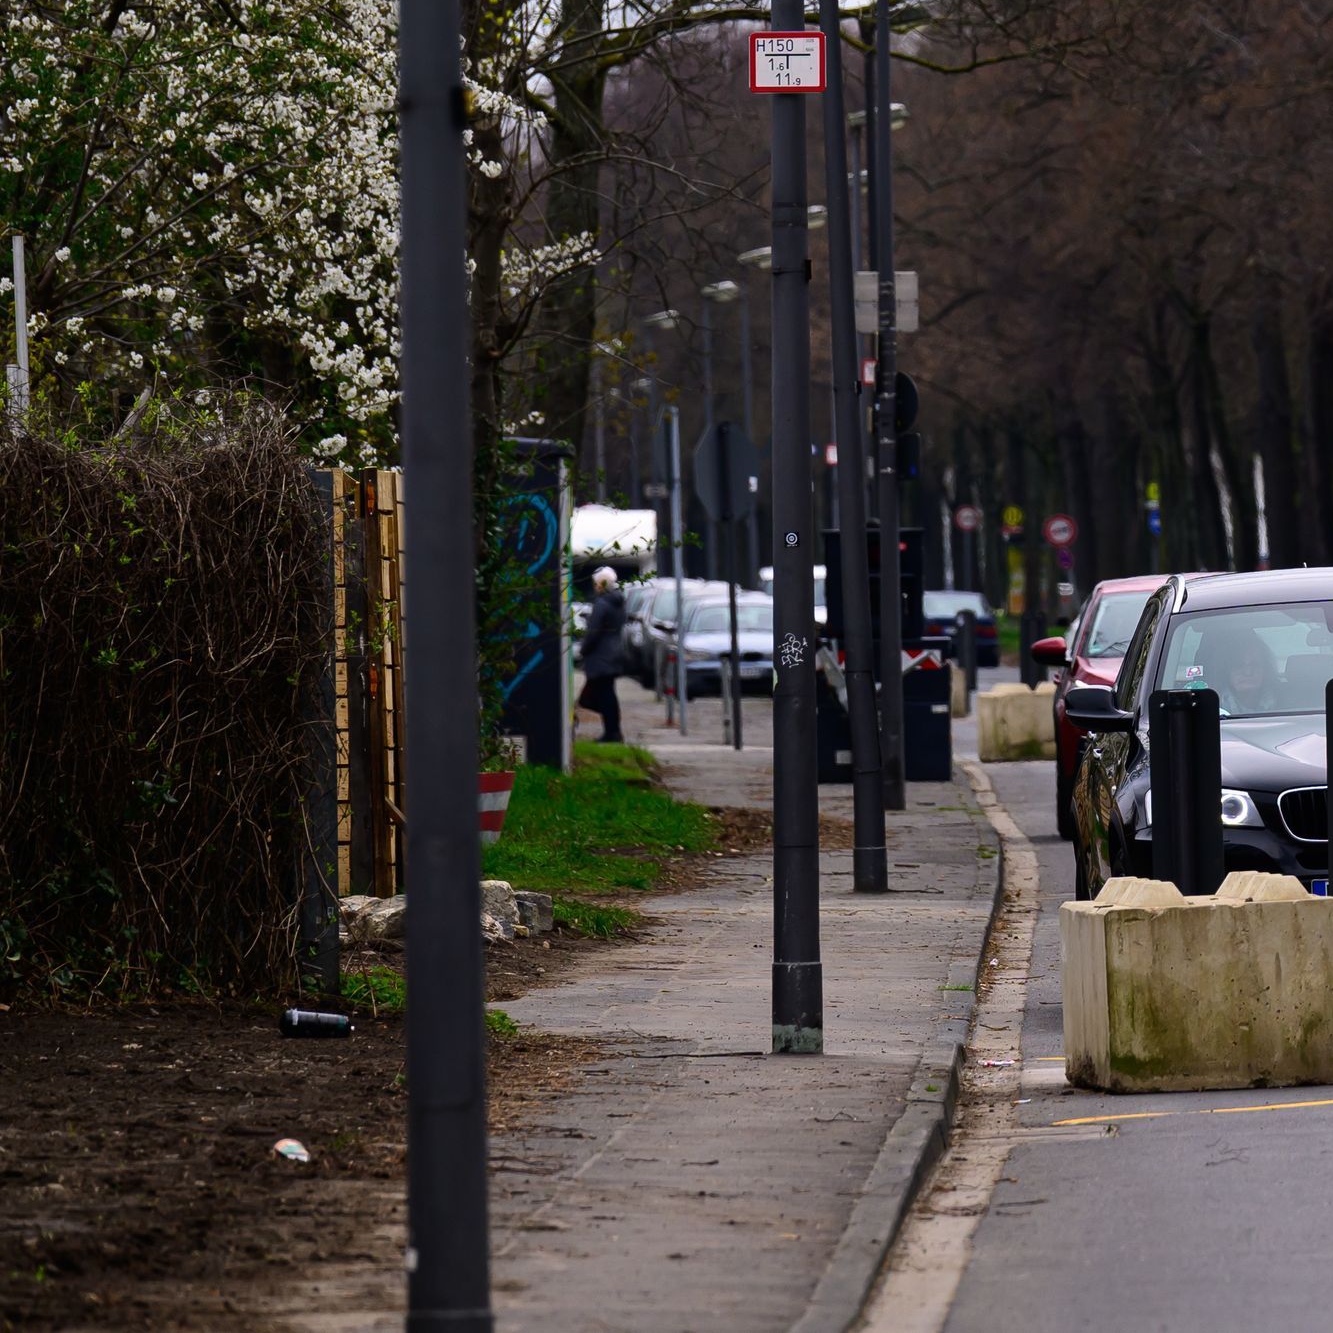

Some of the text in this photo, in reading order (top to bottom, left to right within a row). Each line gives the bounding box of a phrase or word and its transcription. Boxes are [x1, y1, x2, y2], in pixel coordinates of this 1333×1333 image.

[756, 38, 794, 52] H150
[768, 58, 785, 71] 1.6
[775, 72, 801, 86] 11.9
